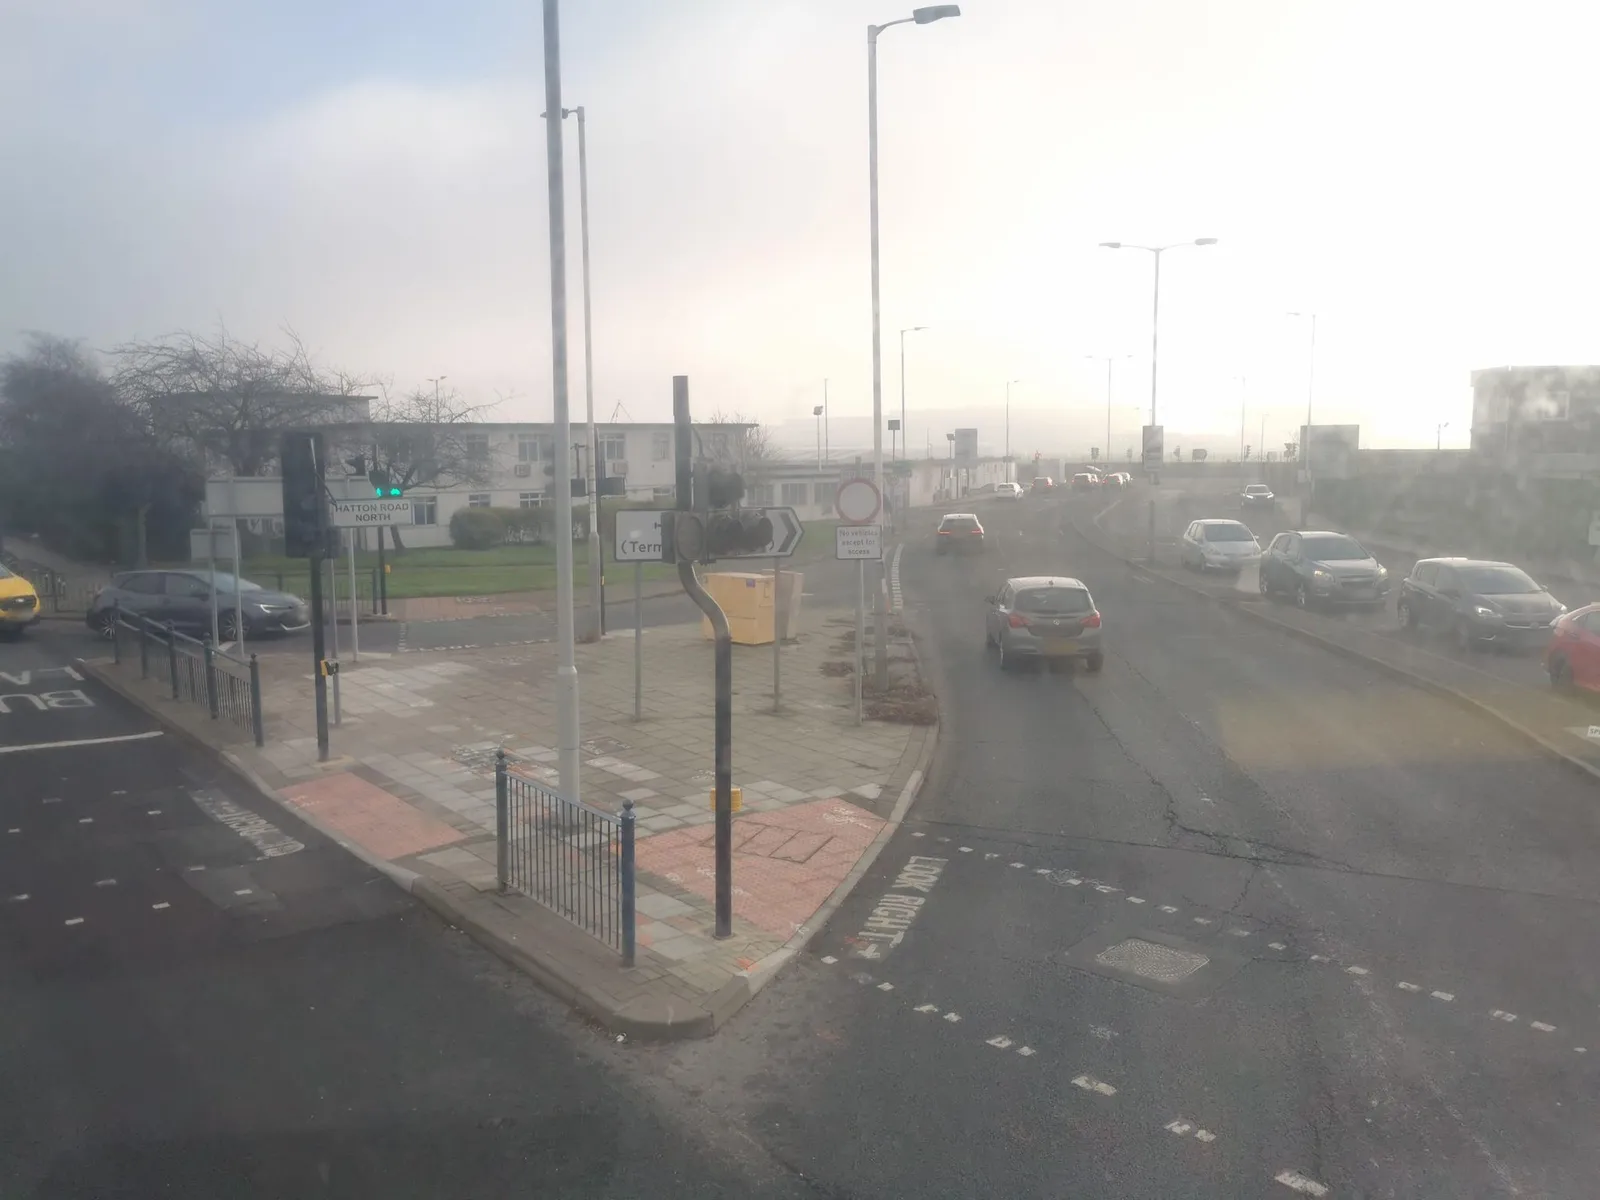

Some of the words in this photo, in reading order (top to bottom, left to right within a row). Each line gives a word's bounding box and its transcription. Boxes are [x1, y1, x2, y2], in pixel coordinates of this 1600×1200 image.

[335, 503, 377, 512] HATTON
[380, 503, 409, 511] ROAD
[355, 513, 391, 522] NORTH
[891, 855, 949, 893] LOOK
[858, 893, 926, 948] RIGHT
